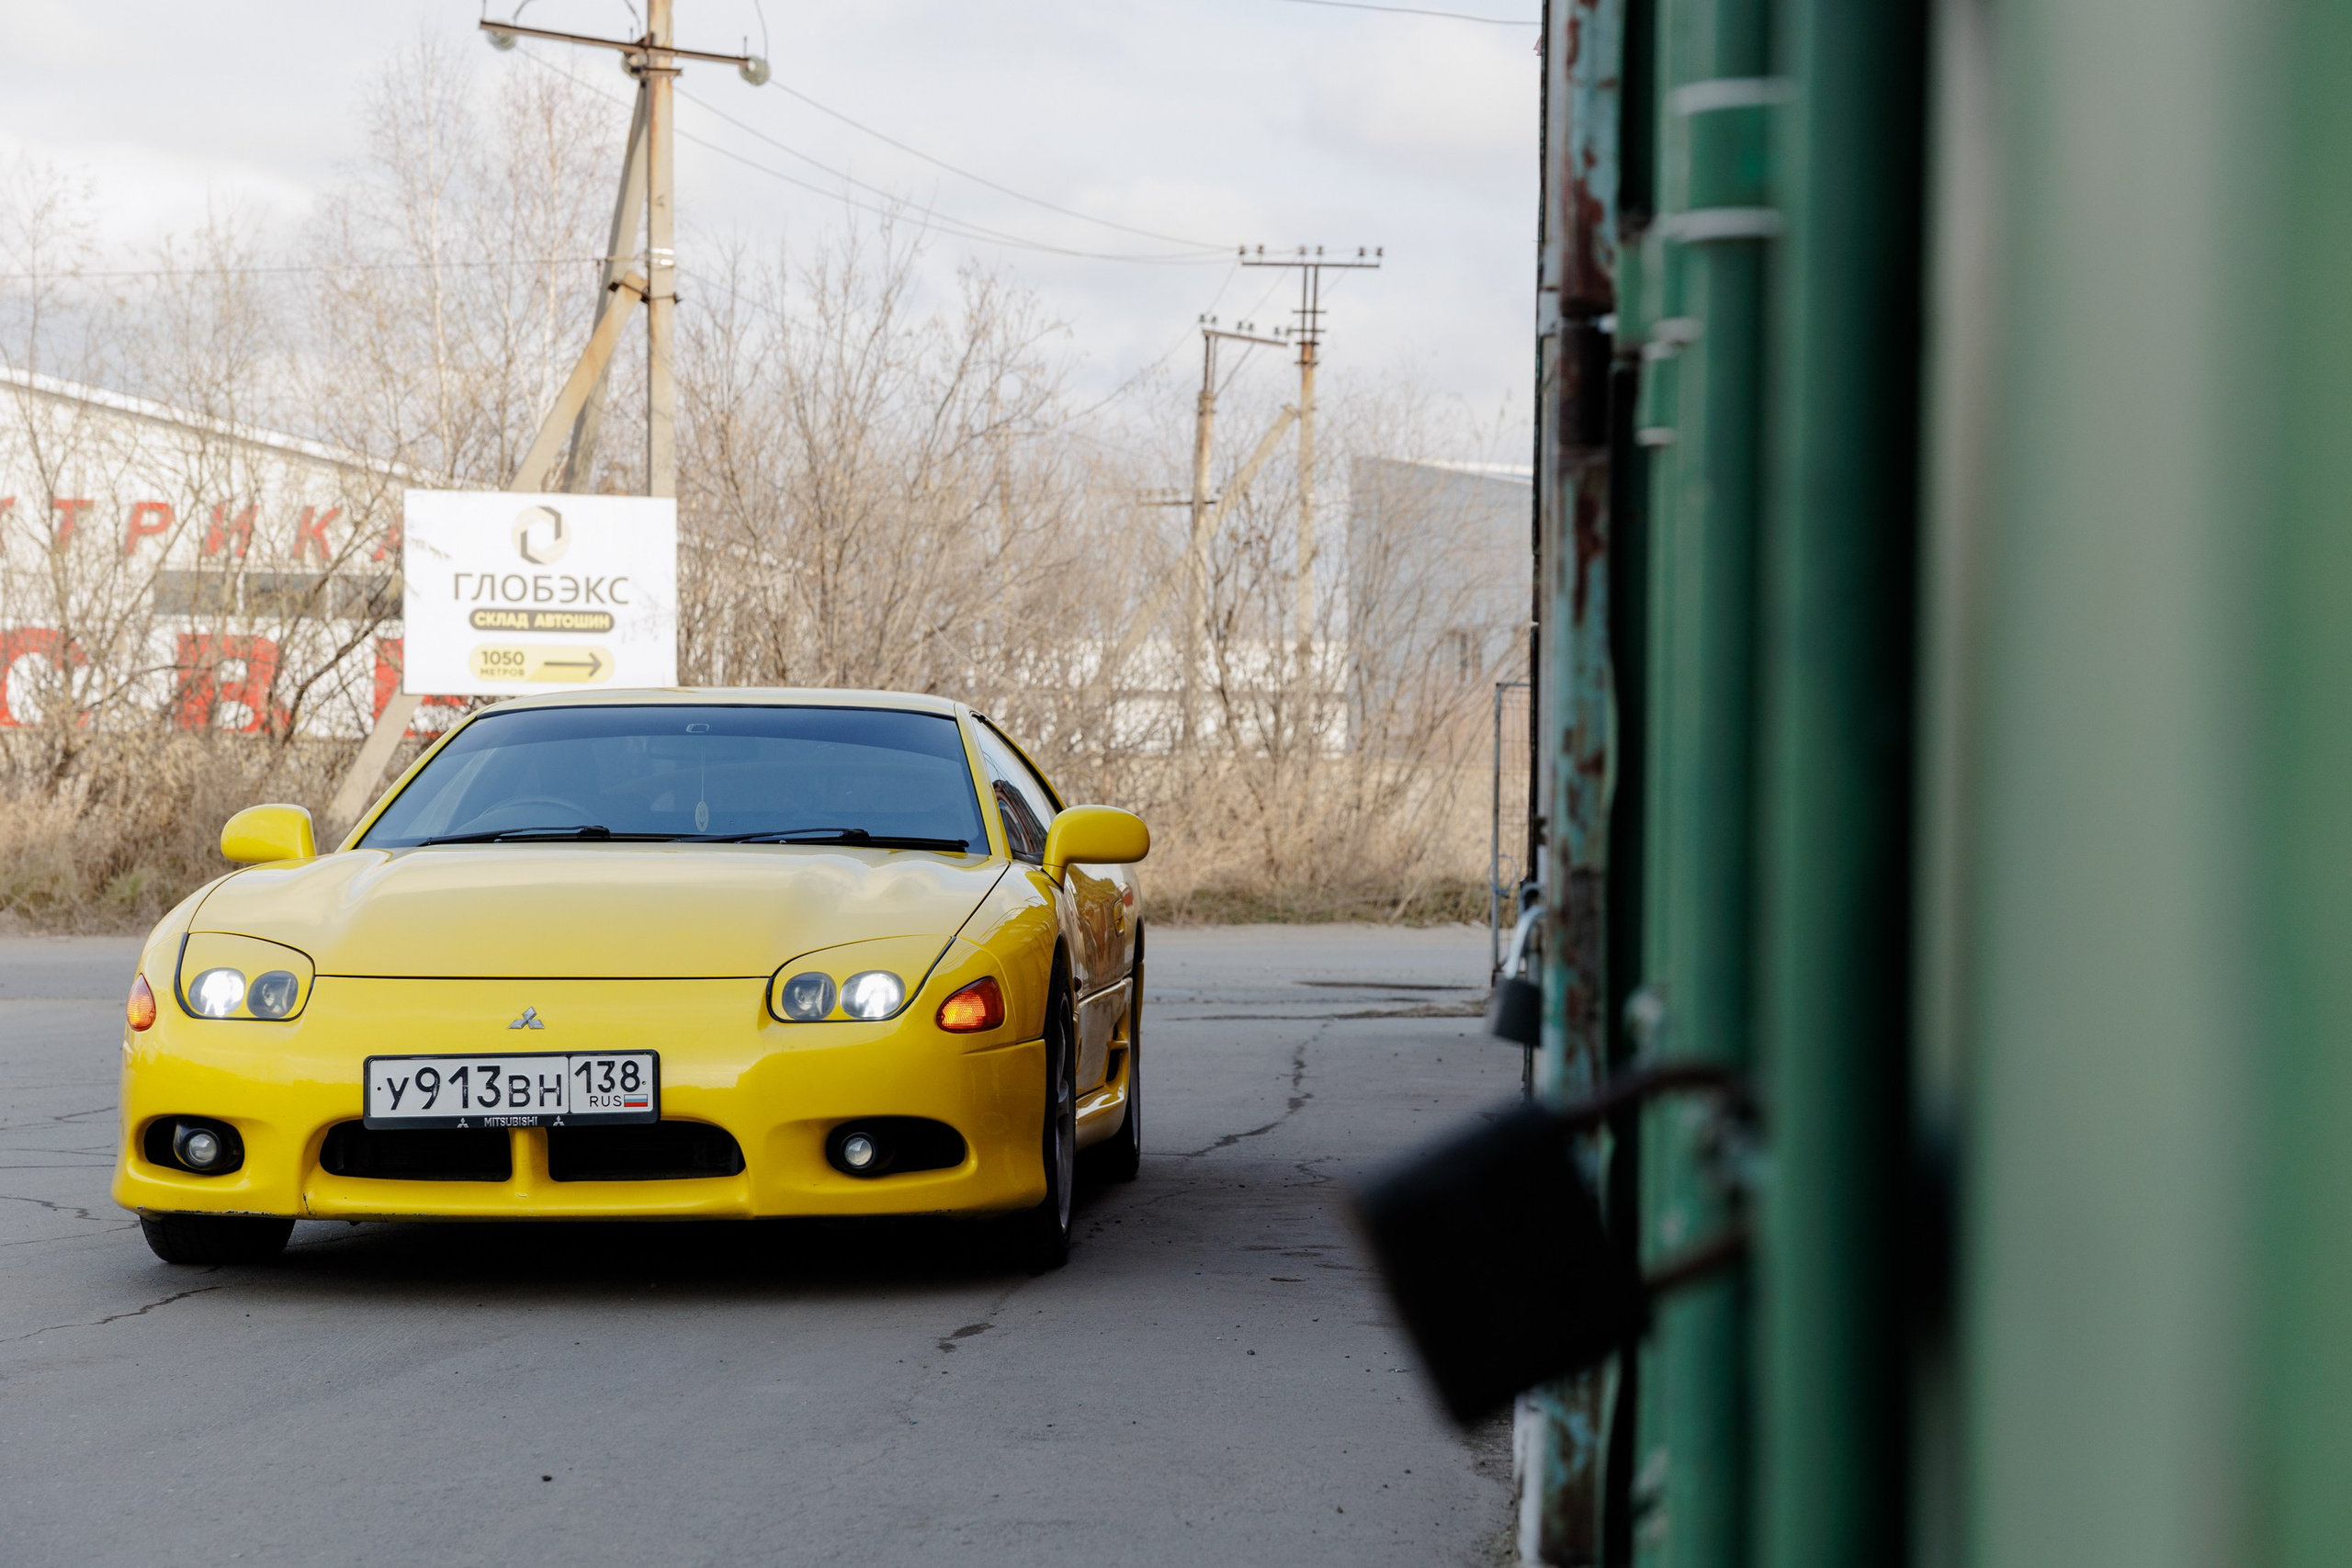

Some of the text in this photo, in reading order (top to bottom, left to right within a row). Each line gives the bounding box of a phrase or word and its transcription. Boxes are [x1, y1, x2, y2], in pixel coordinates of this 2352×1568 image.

[454, 572, 629, 604] ГЛОБЭКС
[473, 610, 611, 629] СКЛАД АВТОШИН
[481, 650, 525, 666] 1050
[480, 668, 525, 677] МЕТРОВ
[386, 1060, 640, 1111] У913ВН 138
[589, 1095, 623, 1108] RUS
[483, 1116, 538, 1128] MITSUBISHI
